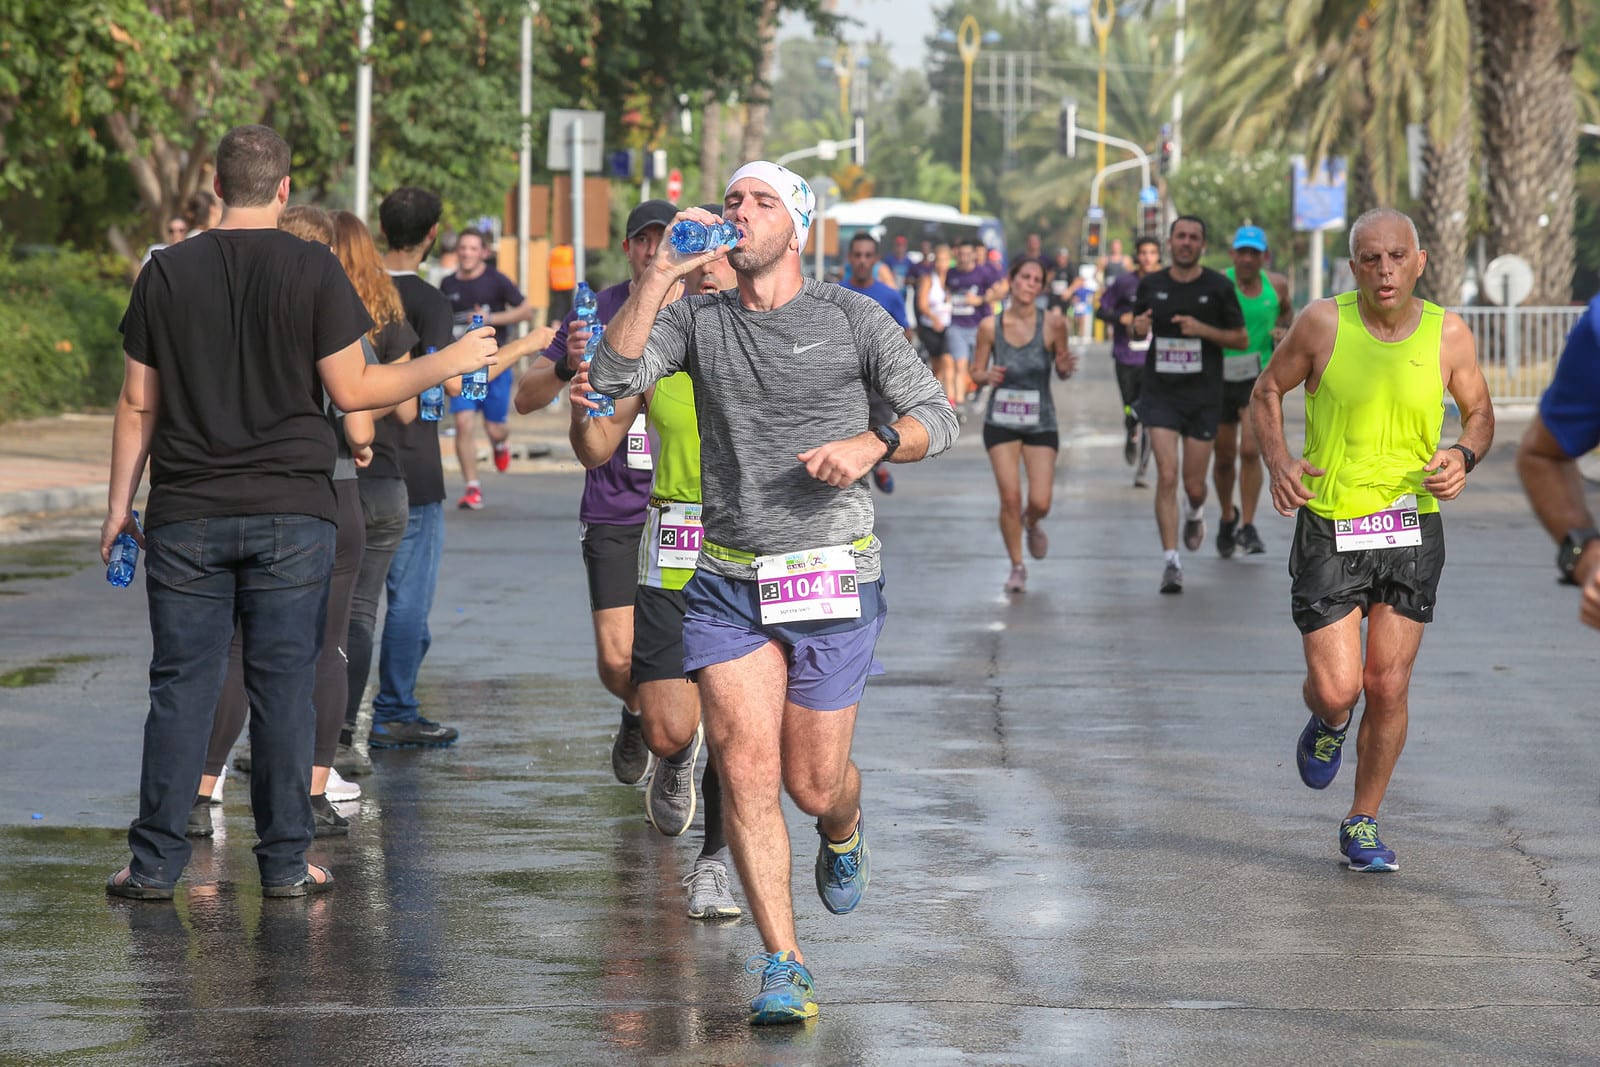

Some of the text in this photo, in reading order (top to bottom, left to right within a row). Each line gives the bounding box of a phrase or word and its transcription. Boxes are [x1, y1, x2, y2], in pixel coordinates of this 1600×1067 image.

[1360, 514, 1394, 533] 480
[680, 530, 704, 548] 11
[783, 575, 836, 599] 1041
